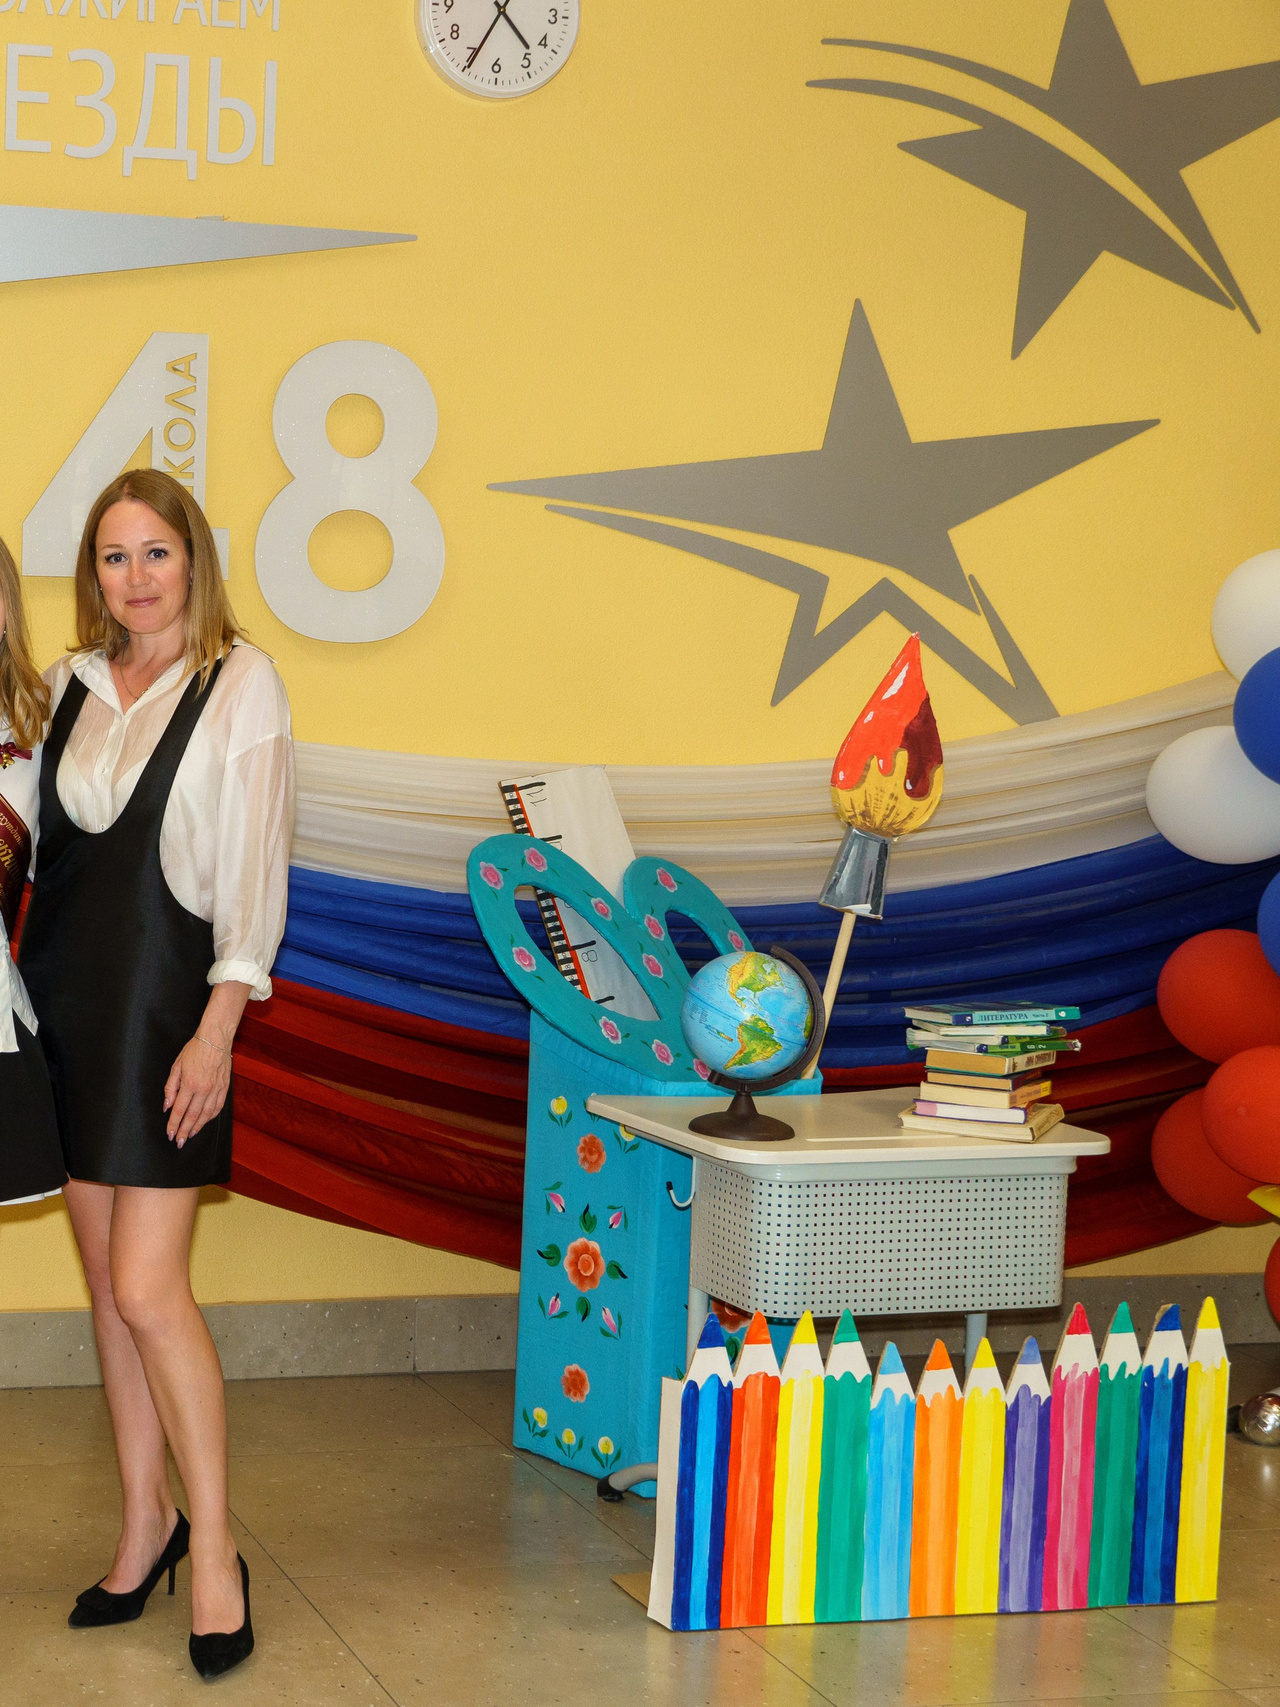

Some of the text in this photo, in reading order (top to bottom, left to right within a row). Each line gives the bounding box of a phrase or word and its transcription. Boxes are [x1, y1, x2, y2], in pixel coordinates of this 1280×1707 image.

[444, 0, 454, 13] 9
[548, 8, 558, 25] 3
[450, 24, 460, 40] 8
[537, 33, 548, 49] 4
[466, 47, 478, 63] 7
[520, 53, 531, 69] 5
[491, 57, 502, 74] 6
[163, 352, 197, 496] КОЛА
[21, 331, 446, 643] 48
[581, 949, 598, 962] 8
[977, 1012, 1029, 1022] ЛИТЕРАТУРА
